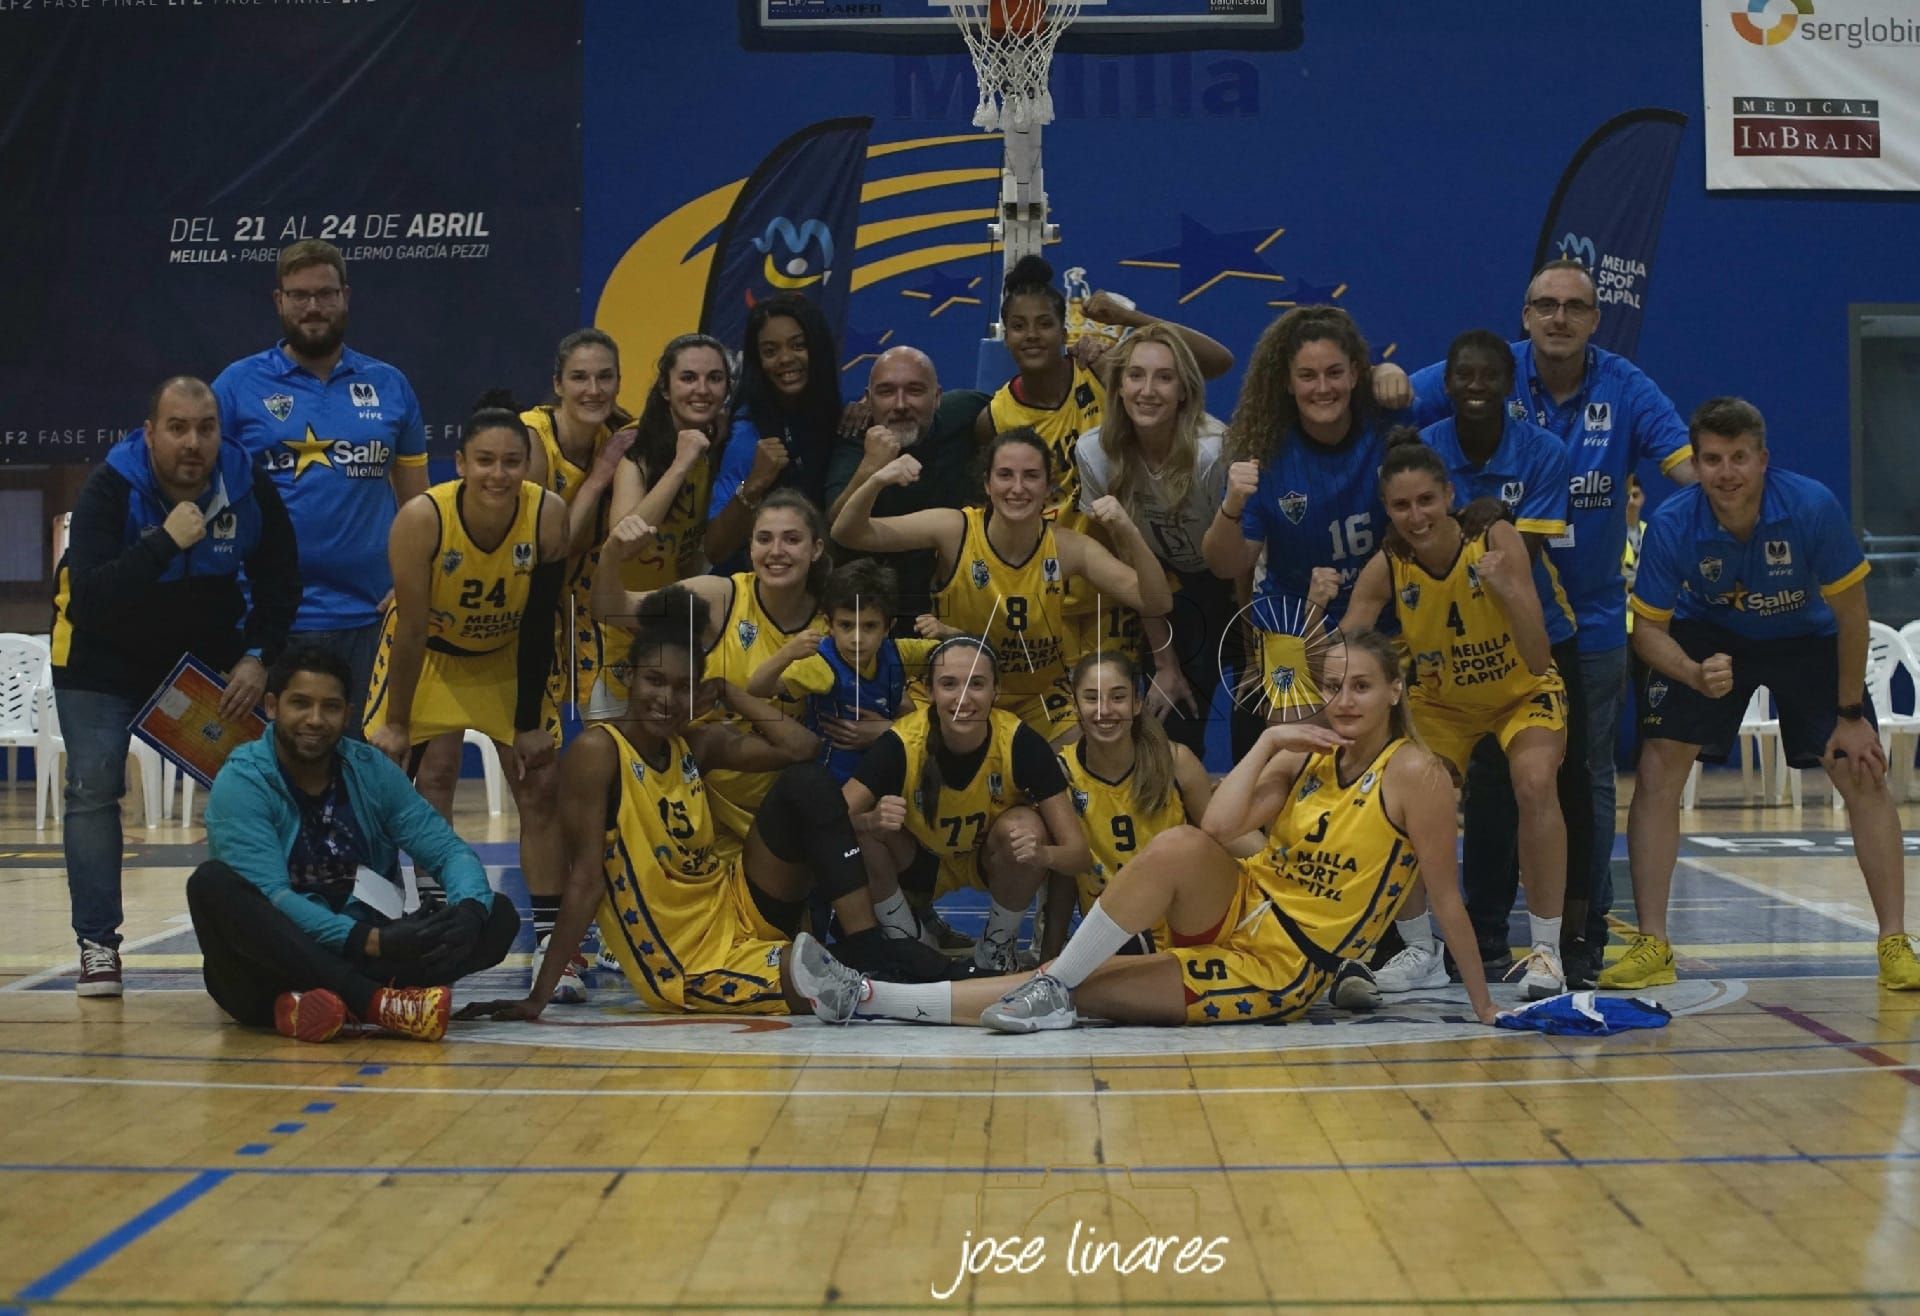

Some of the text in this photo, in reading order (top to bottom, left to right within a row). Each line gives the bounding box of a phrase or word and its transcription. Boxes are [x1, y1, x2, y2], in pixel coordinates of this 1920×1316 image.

[1742, 100, 1871, 114] MEDICAL
[170, 211, 490, 242] DEL 21 AL 24 DE ABRIL
[169, 249, 228, 264] MELILLA
[396, 242, 448, 260] GARCÍA
[451, 243, 490, 258] PEZZI
[38, 429, 87, 444] FASE
[97, 428, 128, 444] FIN
[333, 439, 390, 465] Salle
[1568, 470, 1613, 495] alle
[1571, 496, 1612, 509] elilla
[1328, 511, 1374, 561] 16
[459, 577, 506, 609] 24
[1747, 588, 1807, 610] Salle
[465, 610, 522, 624] MELILL
[1006, 596, 1028, 632] 8
[1446, 601, 1466, 637] 4
[1451, 632, 1511, 659] MELILLA
[1452, 650, 1506, 675] SPORT
[1453, 656, 1519, 687] CAPITAL
[940, 811, 986, 849] 77
[1110, 814, 1137, 853] 9
